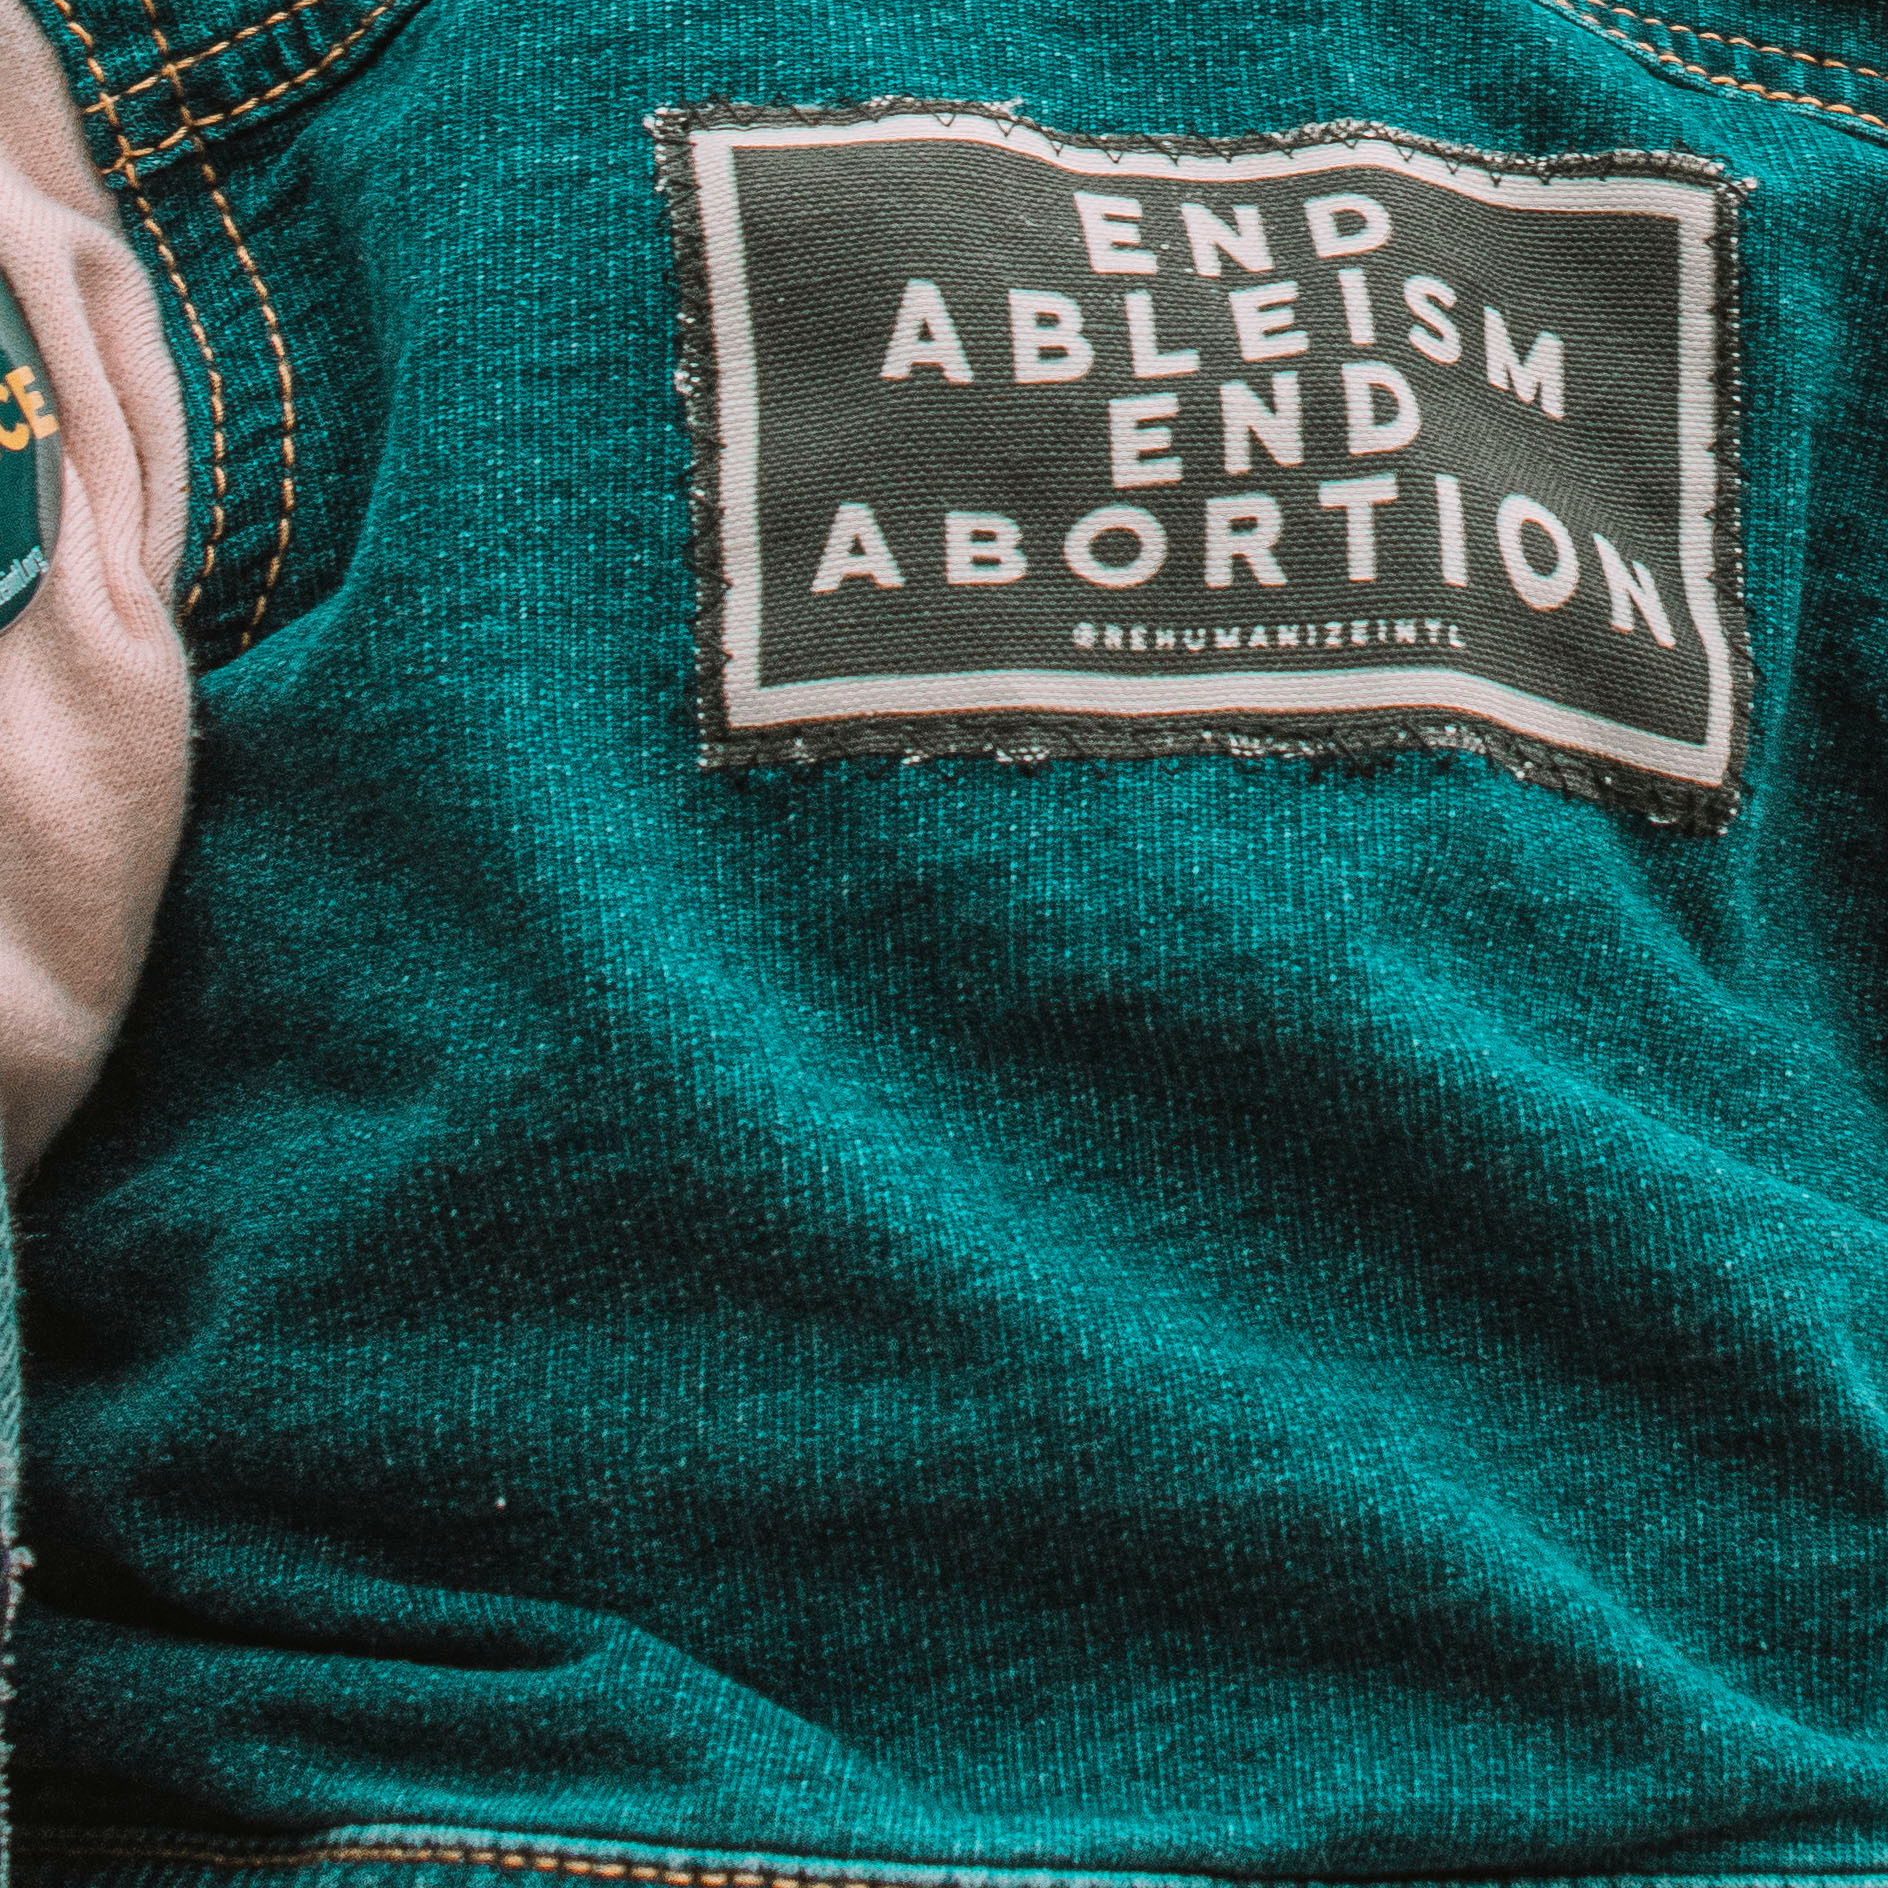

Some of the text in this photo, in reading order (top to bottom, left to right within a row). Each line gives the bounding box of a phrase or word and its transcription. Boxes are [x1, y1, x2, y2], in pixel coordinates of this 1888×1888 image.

[1072, 189, 1393, 277] END
[880, 267, 1564, 420] ABLEISM
[1107, 360, 1422, 488] END
[811, 473, 1676, 648] ABORTION
